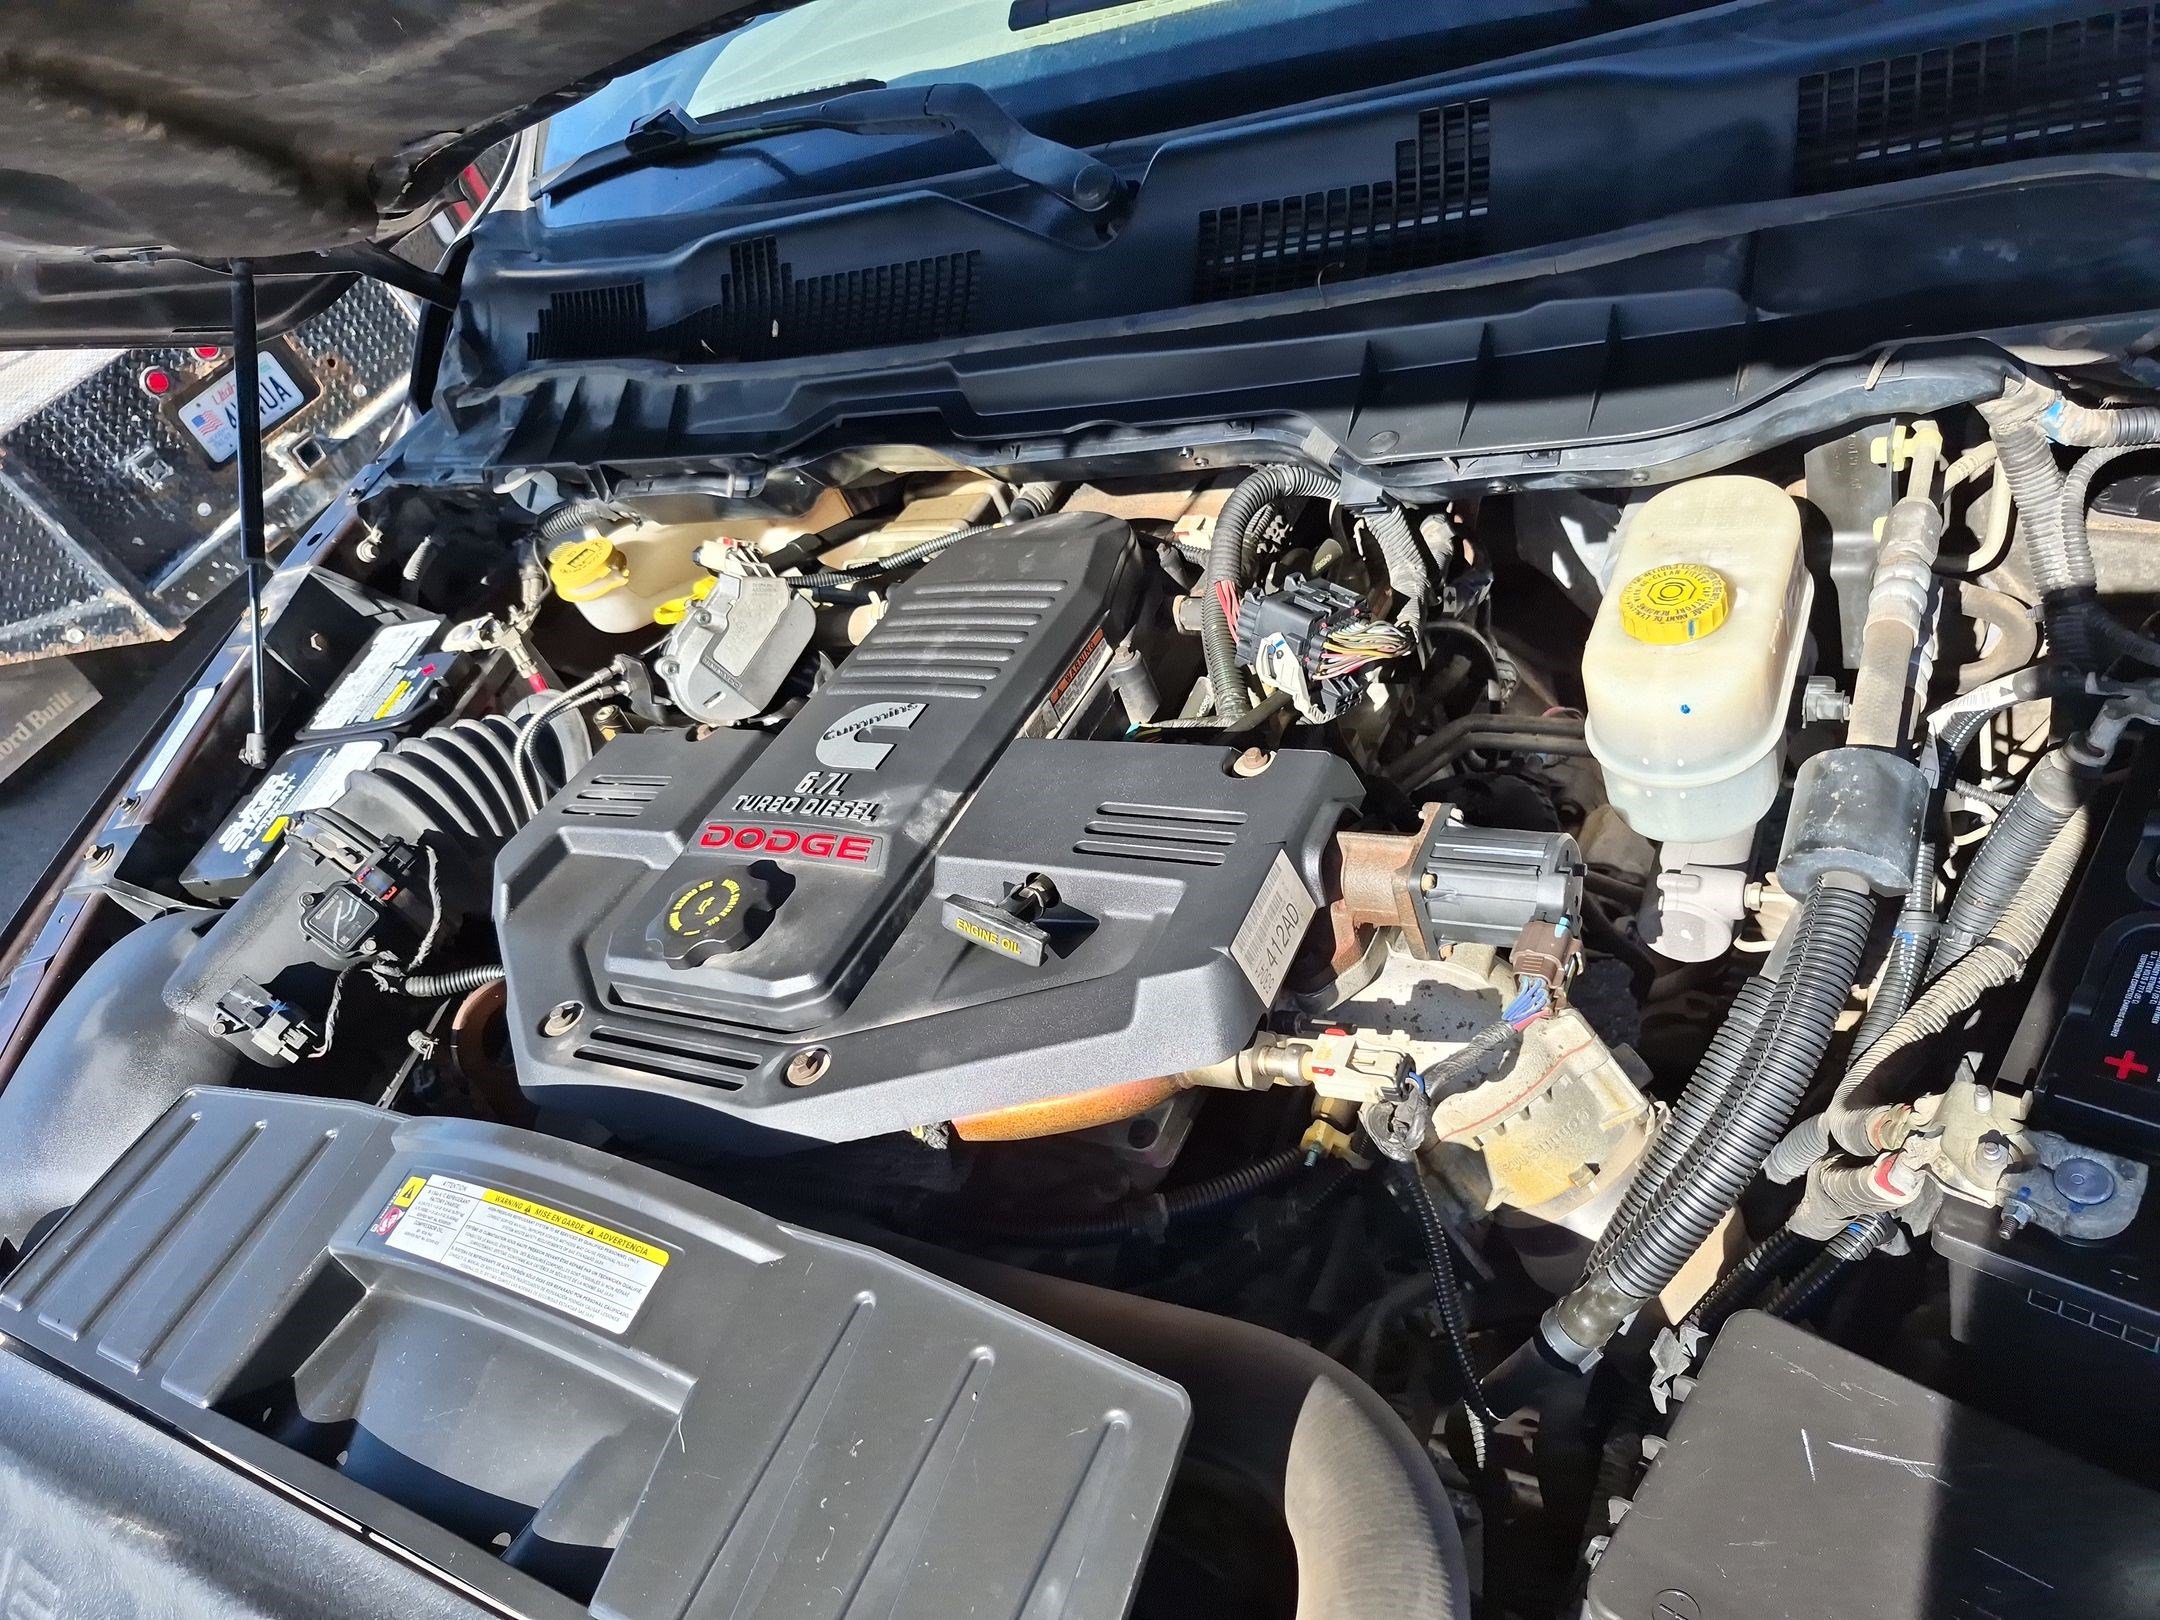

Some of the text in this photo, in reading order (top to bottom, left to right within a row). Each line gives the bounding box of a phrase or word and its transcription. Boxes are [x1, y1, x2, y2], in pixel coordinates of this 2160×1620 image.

[1065, 641, 1096, 683] WARNING
[0, 690, 75, 761] ord Built
[821, 702, 919, 741] Cummins
[794, 770, 853, 797] 6.7L
[731, 793, 881, 822] TURBO DIESEL
[698, 822, 876, 863] DODGE
[954, 916, 1023, 957] ENGINE OIL
[1266, 902, 1300, 968] 412AD
[494, 1194, 524, 1210] WARNING
[534, 1208, 552, 1220] MISE
[551, 1213, 562, 1223] EN
[561, 1217, 586, 1232] GARDE
[597, 1231, 651, 1256] ADVERTENCIA
